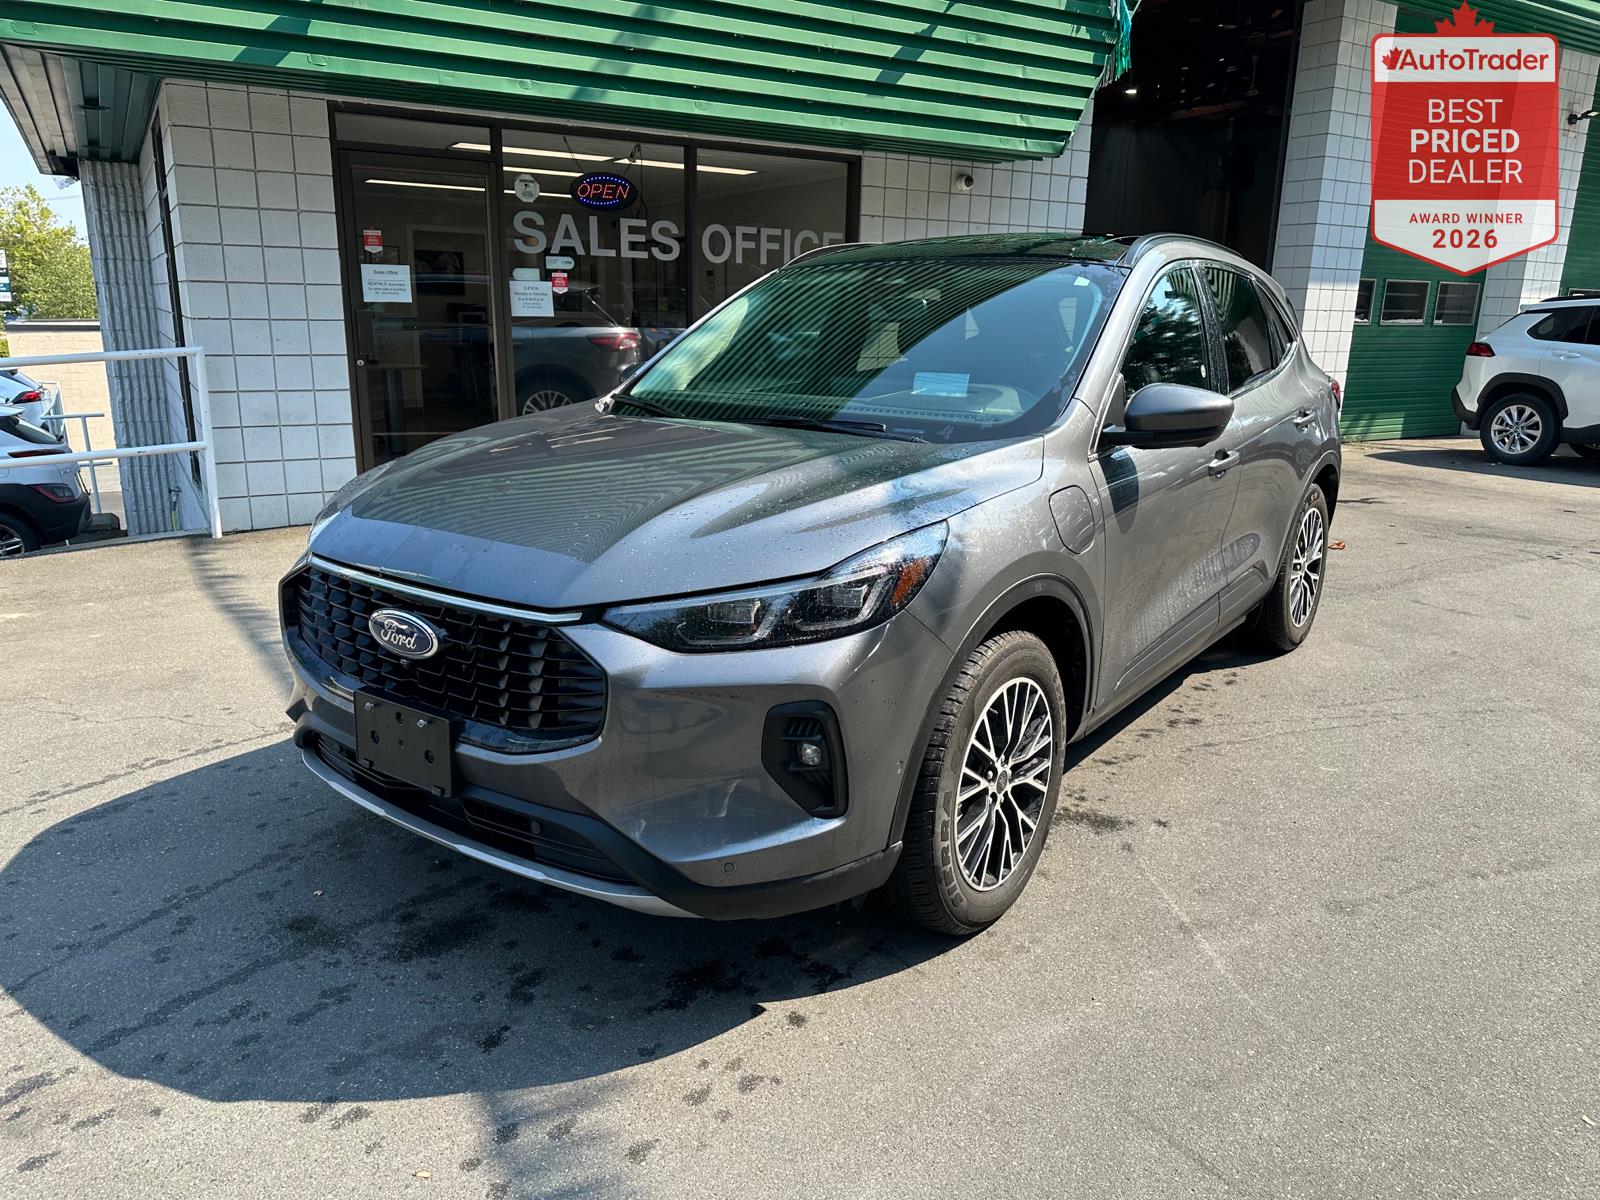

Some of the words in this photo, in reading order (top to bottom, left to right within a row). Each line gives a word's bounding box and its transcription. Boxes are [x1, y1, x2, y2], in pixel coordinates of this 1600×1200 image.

[577, 183, 630, 199] OPEN
[513, 210, 680, 261] SALES
[380, 619, 417, 650] Ford
[941, 791, 963, 907] SIERRA
